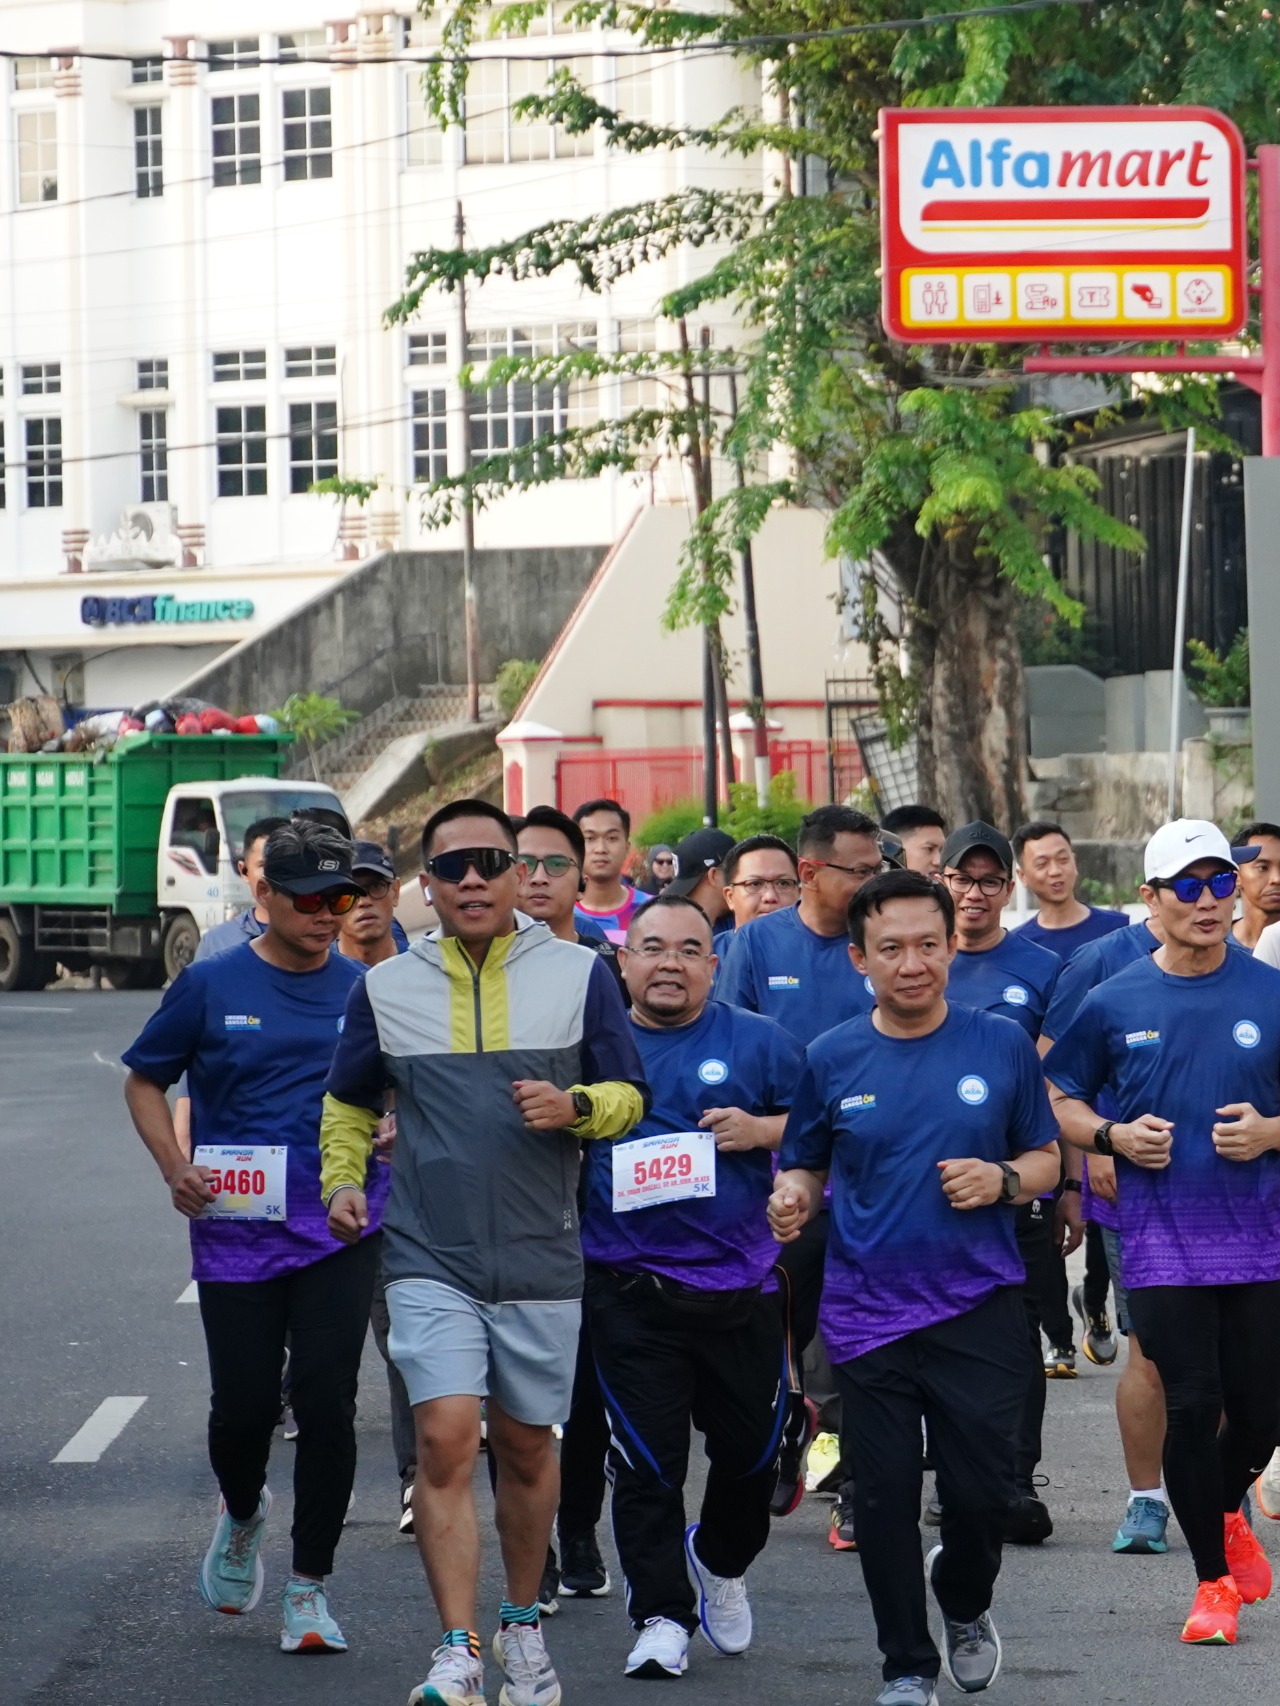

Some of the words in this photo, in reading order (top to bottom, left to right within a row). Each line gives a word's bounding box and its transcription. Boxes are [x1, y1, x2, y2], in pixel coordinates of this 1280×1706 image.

[921, 138, 1213, 189] Alfamart
[206, 887, 219, 899] 40
[633, 1153, 692, 1186] 5429
[210, 1169, 265, 1196] 5460
[693, 1182, 710, 1193] 5K
[265, 1205, 281, 1215] 5K
